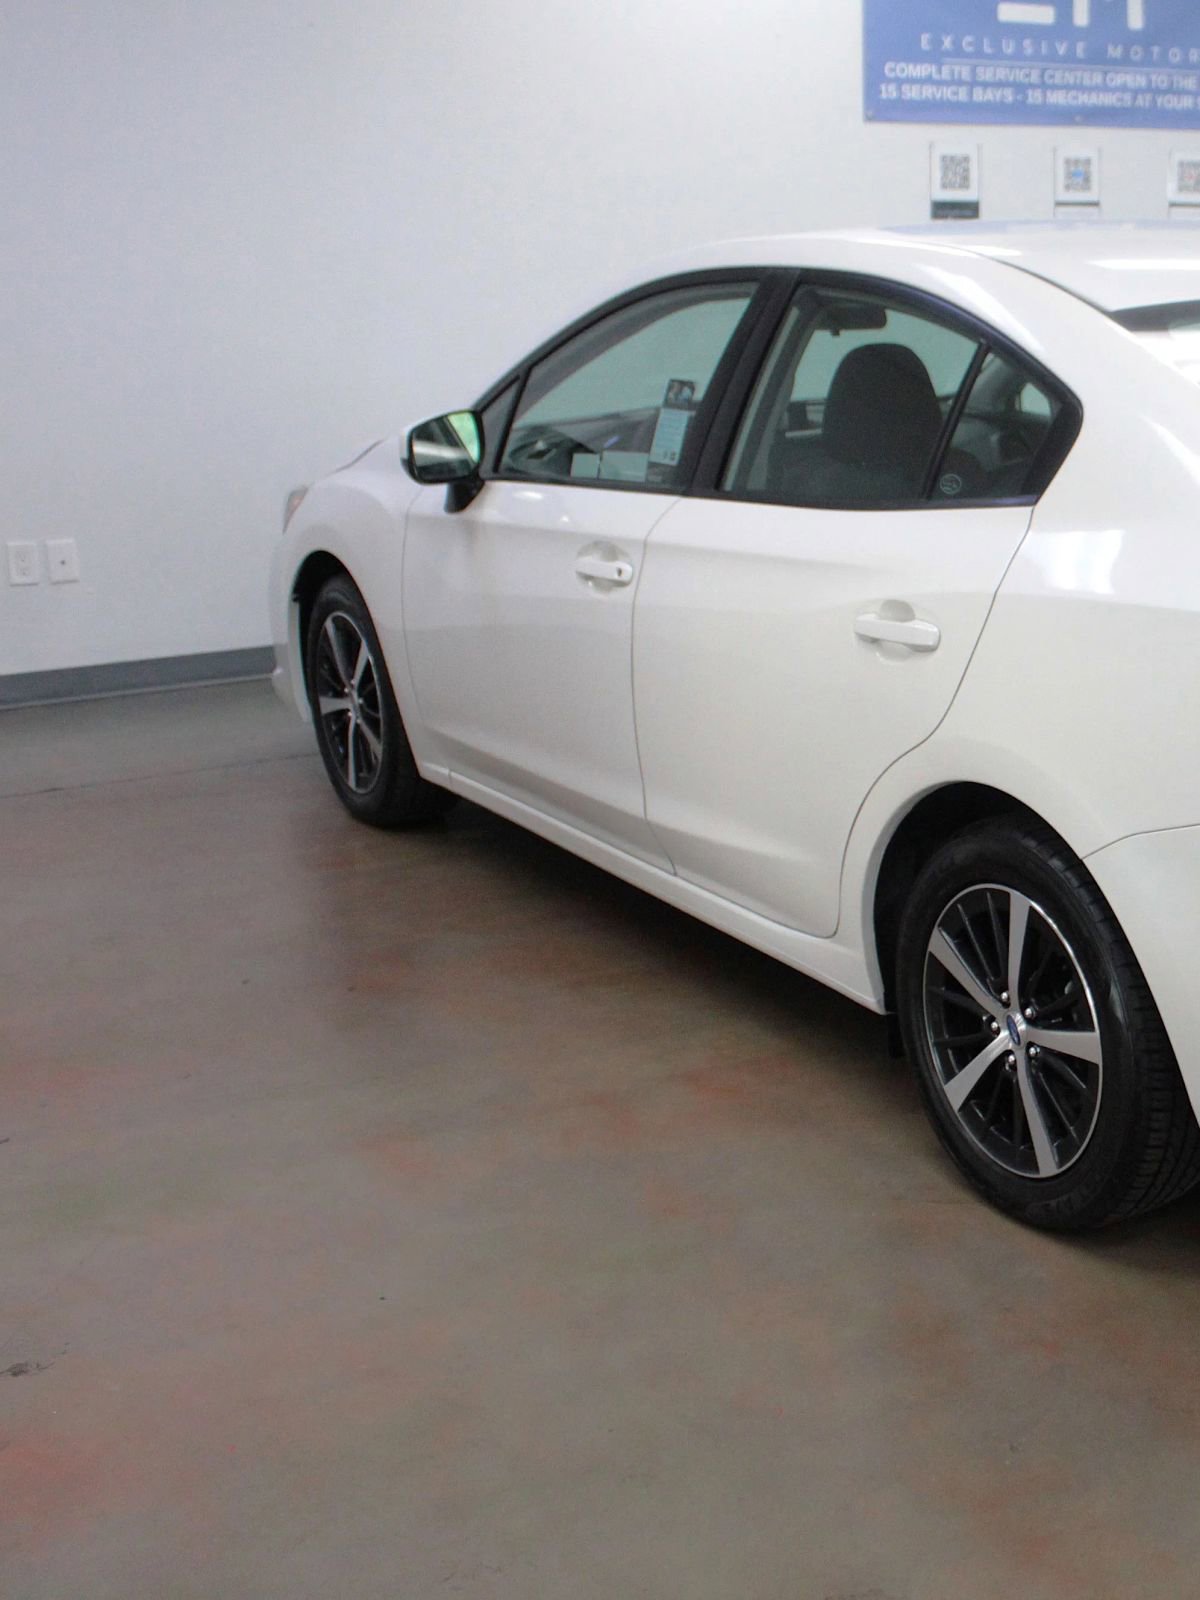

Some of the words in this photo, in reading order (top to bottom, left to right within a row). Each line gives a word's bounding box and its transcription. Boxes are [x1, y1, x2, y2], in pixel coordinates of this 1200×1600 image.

[920, 33, 1087, 58] EXCLUSIVE
[884, 61, 971, 81] COMPLETE
[975, 66, 1041, 84] SERVICE
[1044, 69, 1102, 86] CENTER
[1106, 72, 1147, 88] OPEN
[1151, 74, 1168, 89] TO
[1172, 74, 1198, 91] THE
[880, 83, 897, 99] 15
[901, 83, 969, 102] SERVICE
[973, 86, 1014, 104] BAYS
[1026, 89, 1042, 104] 15
[1046, 89, 1132, 108] MECHANICS
[1134, 93, 1152, 108] AT
[1155, 94, 1194, 110] YOUR
